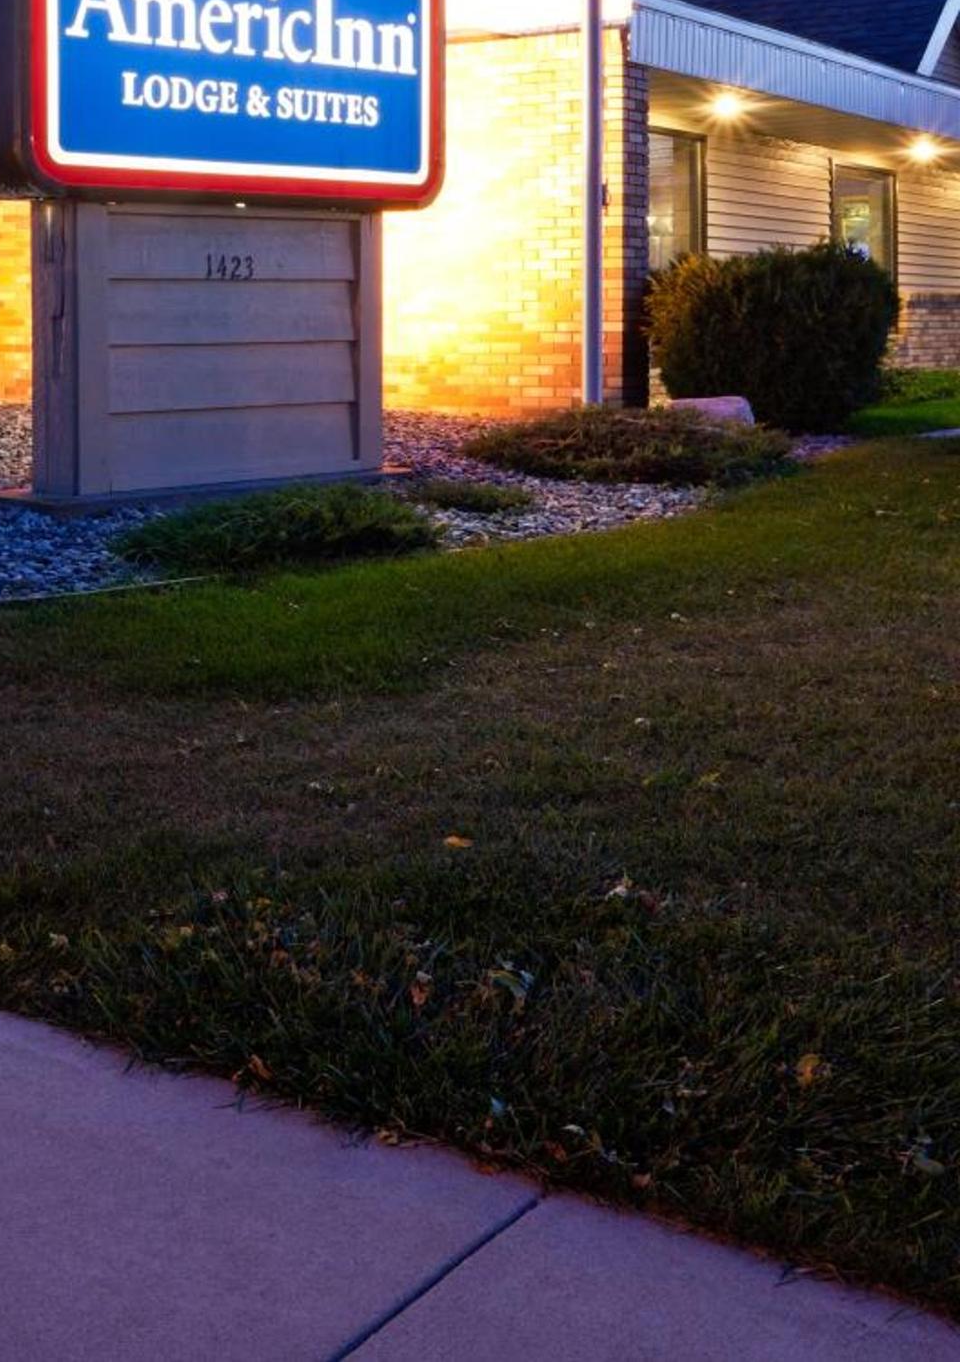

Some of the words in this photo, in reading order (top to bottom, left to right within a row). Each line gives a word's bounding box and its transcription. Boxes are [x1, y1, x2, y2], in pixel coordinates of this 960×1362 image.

[121, 71, 238, 114] LODGE
[246, 84, 271, 118] &
[276, 87, 379, 127] SUITES
[206, 253, 254, 280] 1423
